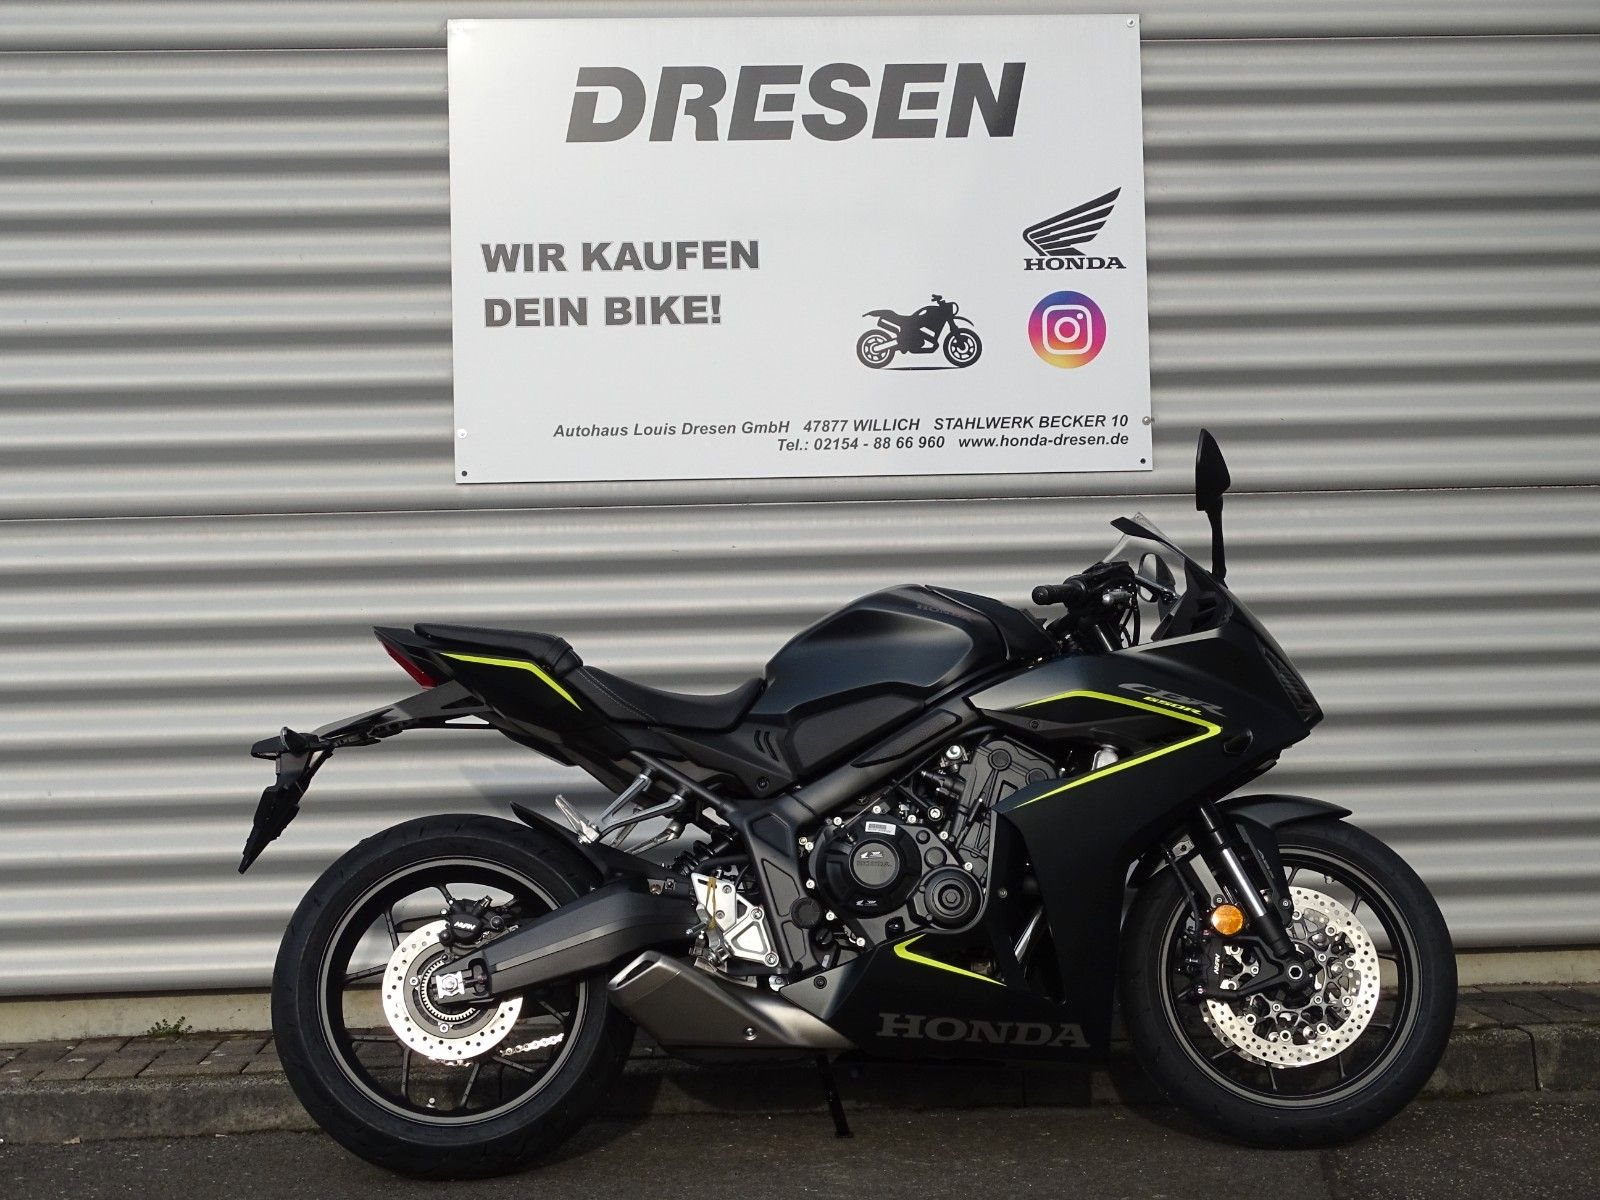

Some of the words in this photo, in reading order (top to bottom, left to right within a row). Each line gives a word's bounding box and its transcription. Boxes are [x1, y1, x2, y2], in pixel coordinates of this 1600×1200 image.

[566, 62, 1026, 142] DRESEN
[481, 243, 566, 273] WIR
[582, 240, 760, 272] KAUFEN
[1023, 256, 1127, 271] HONDA
[484, 297, 588, 328] DEIN
[605, 295, 722, 326] BIKE!
[553, 424, 629, 437] Autohaus
[634, 422, 677, 436] Louis
[681, 422, 737, 435] Dresen
[741, 420, 790, 434] GmbH
[803, 419, 849, 433] 47877
[853, 418, 920, 432] WILLICH
[934, 416, 1034, 431] STAHLWERK
[1039, 415, 1107, 429] BECKER
[1111, 414, 1129, 428] 10
[777, 438, 809, 452] Tel.:
[813, 437, 859, 451] 02154
[873, 436, 891, 450] 88
[895, 436, 914, 449] 66
[918, 435, 945, 449] 960
[958, 432, 1129, 448] www.honda-dresen.de
[876, 1012, 1091, 1048] HONDA
